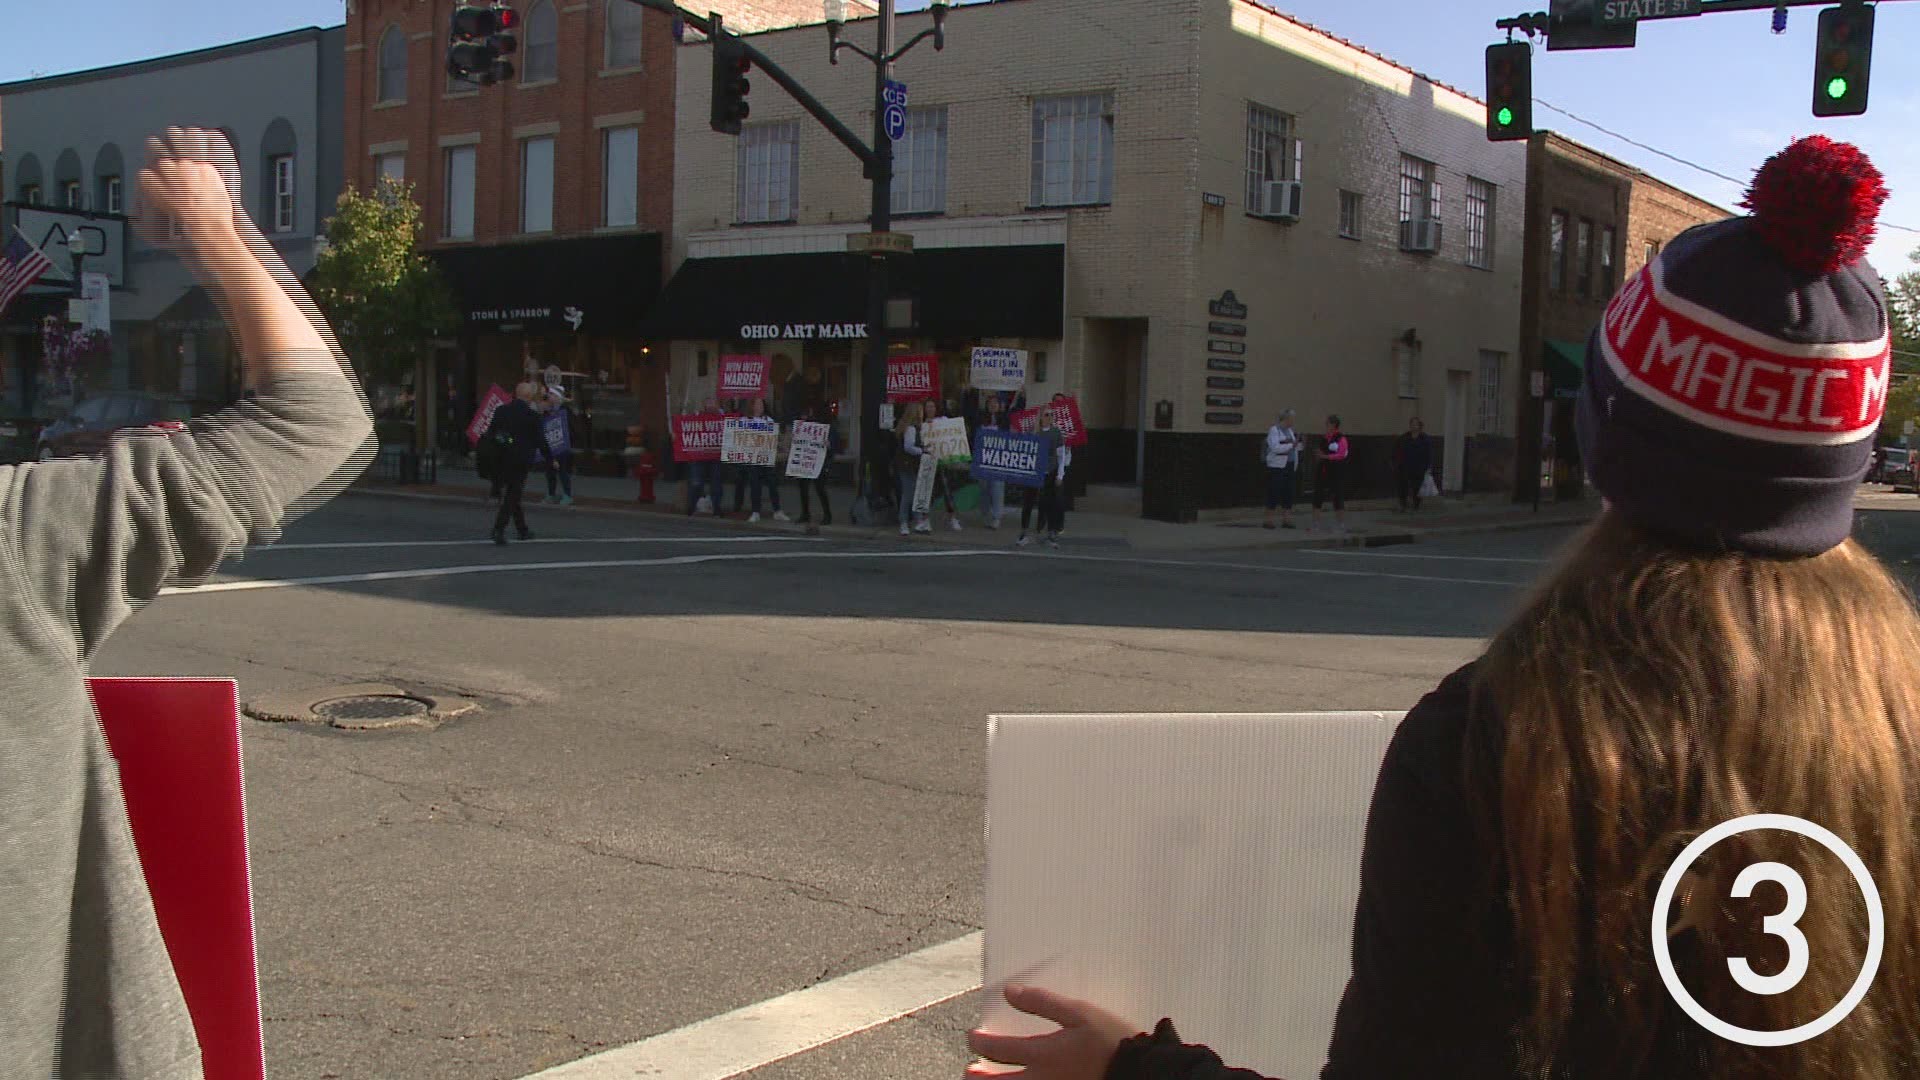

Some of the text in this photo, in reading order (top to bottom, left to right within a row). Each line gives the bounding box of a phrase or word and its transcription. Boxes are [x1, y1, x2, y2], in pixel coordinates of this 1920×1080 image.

[1604, 0, 1688, 19] STATE ST
[471, 311, 499, 320] STONE
[510, 308, 551, 319] SPARROW
[740, 323, 868, 339] OHIO ART MARK
[726, 361, 763, 372] WIN WITH
[901, 362, 929, 374] WITH
[1641, 317, 1848, 426] MAGIC
[724, 372, 762, 386] WARREN
[681, 421, 703, 432] WIN
[983, 435, 1039, 454] WIN WITH
[982, 448, 1037, 470] WARREN
